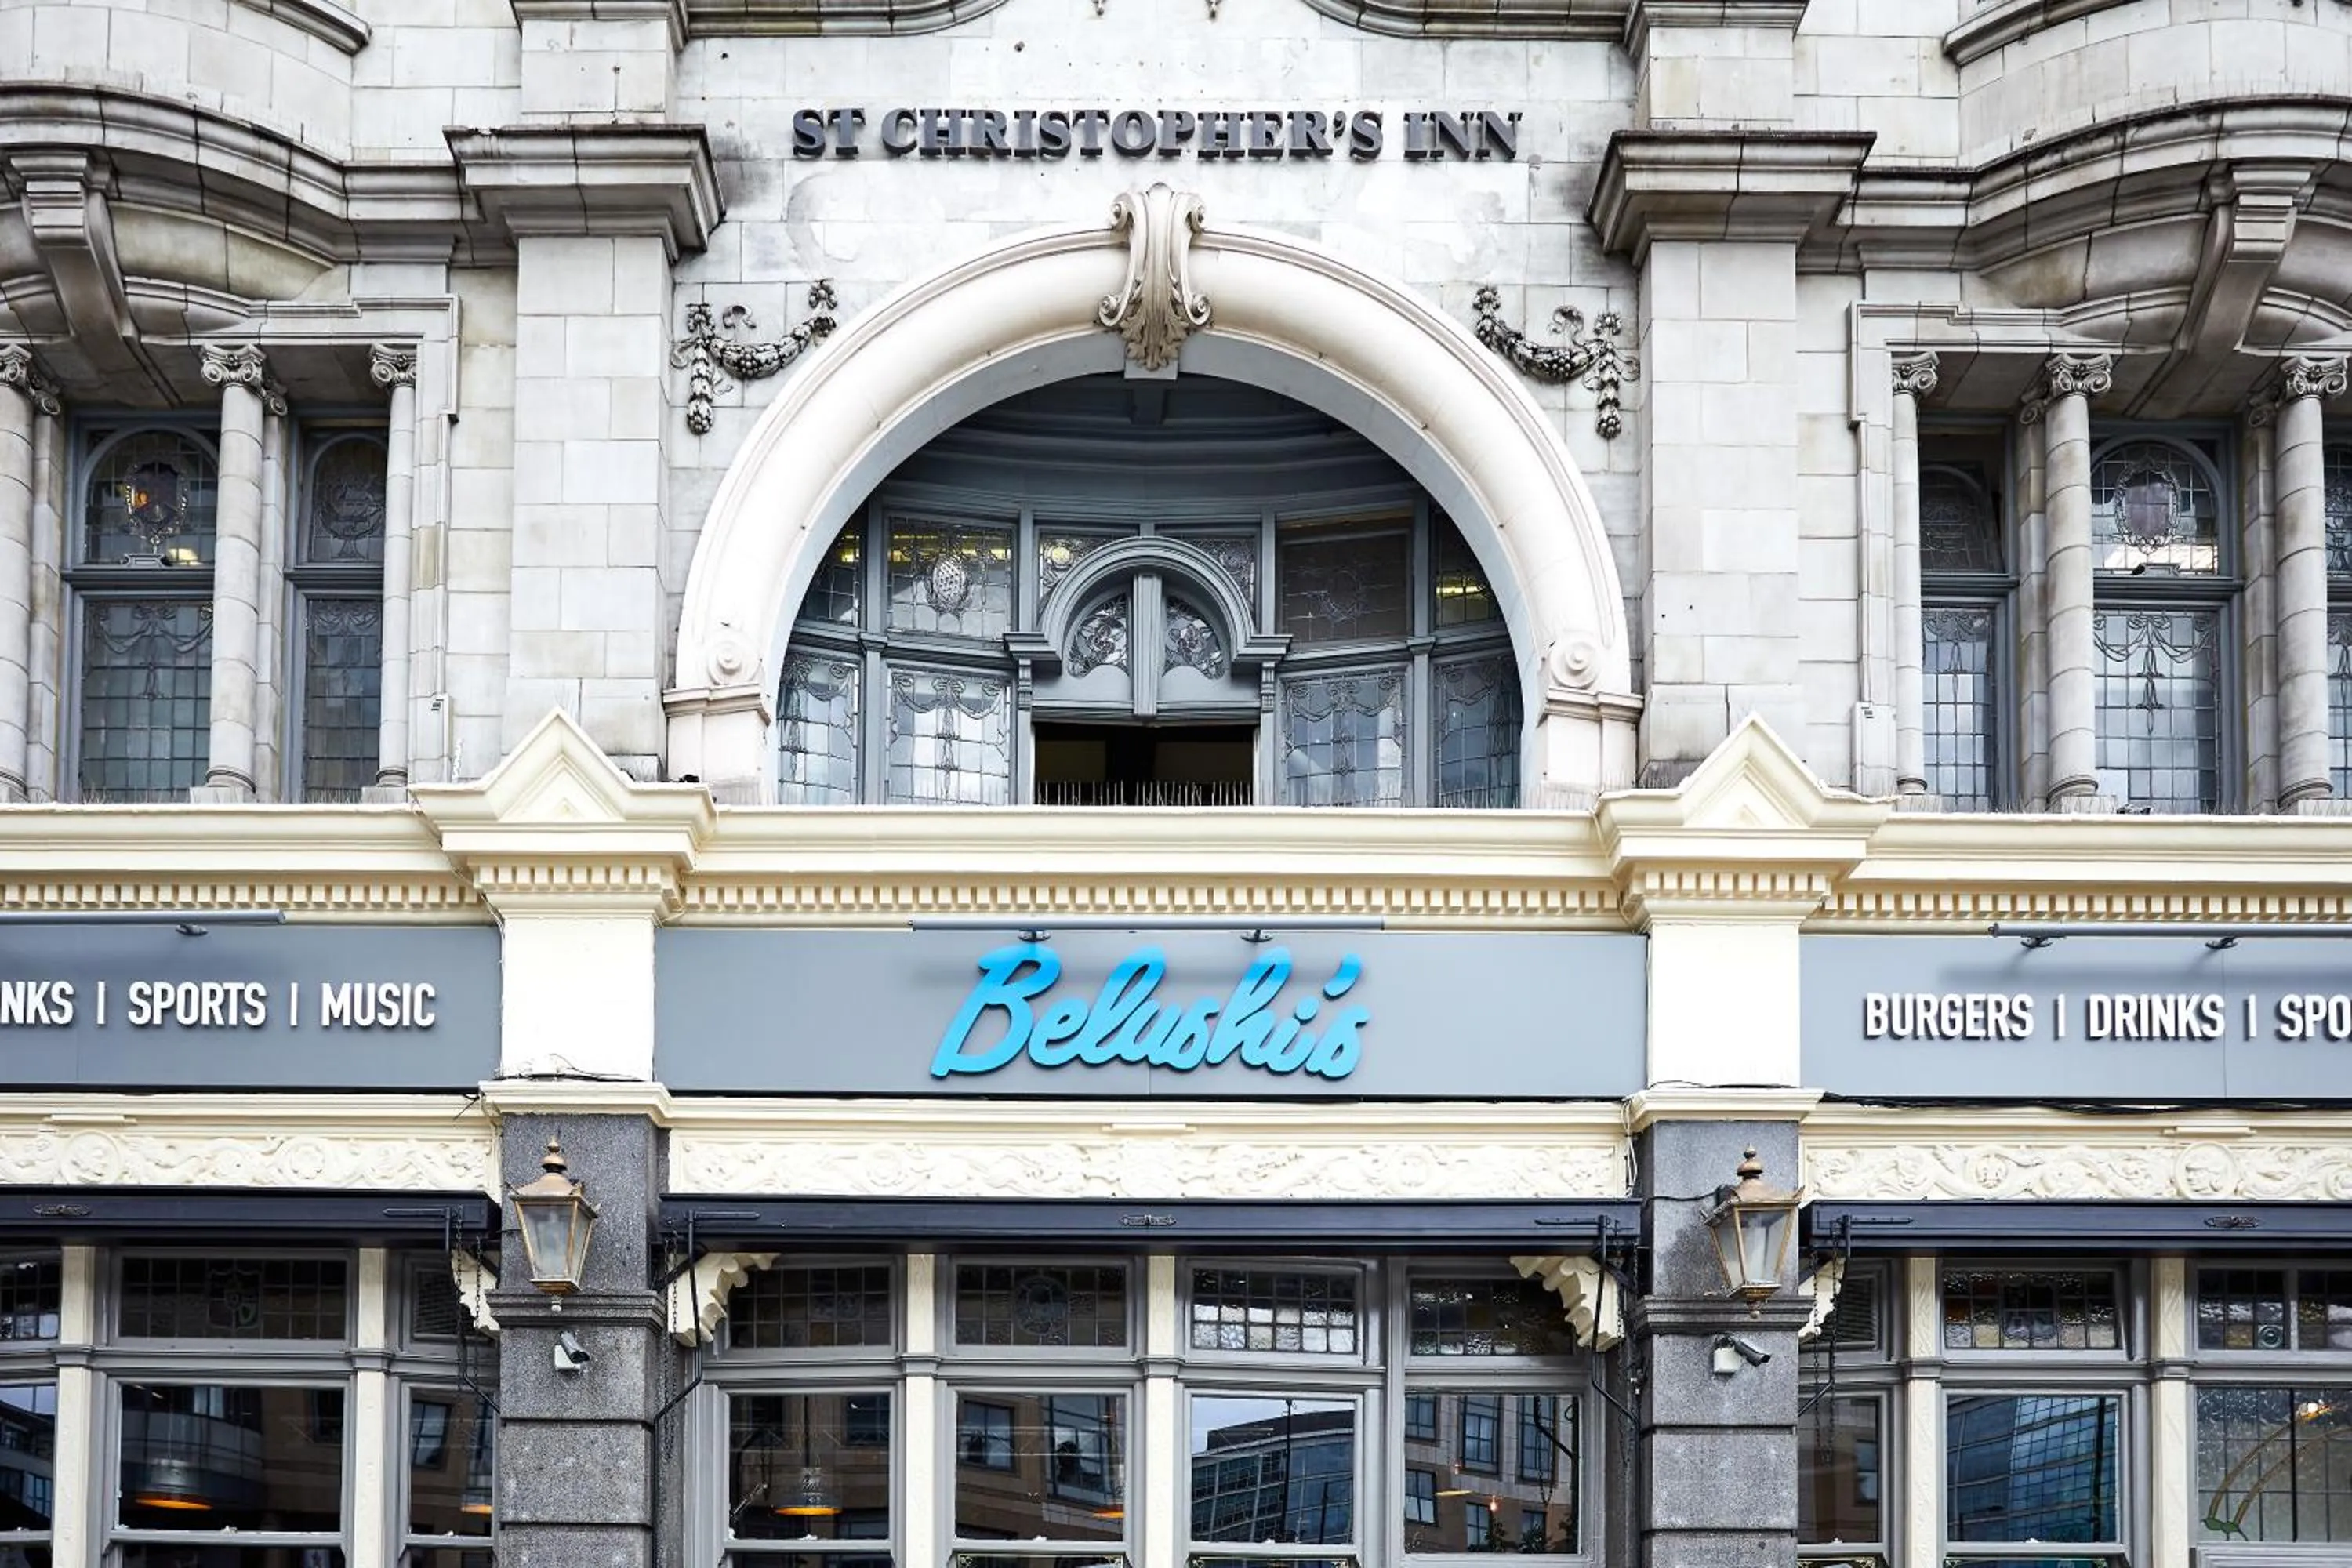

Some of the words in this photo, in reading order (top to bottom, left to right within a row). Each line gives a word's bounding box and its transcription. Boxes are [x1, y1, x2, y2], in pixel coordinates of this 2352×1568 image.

[793, 108, 866, 156] ST
[881, 109, 1383, 159] CHRISTOPHER'S
[1404, 111, 1523, 159] INN
[128, 981, 267, 1026] SPORTS
[321, 982, 436, 1027] MUSIC
[931, 943, 1370, 1079] Belushi's
[1865, 993, 2034, 1038] BURGERS
[2089, 993, 2225, 1038] DRINKS
